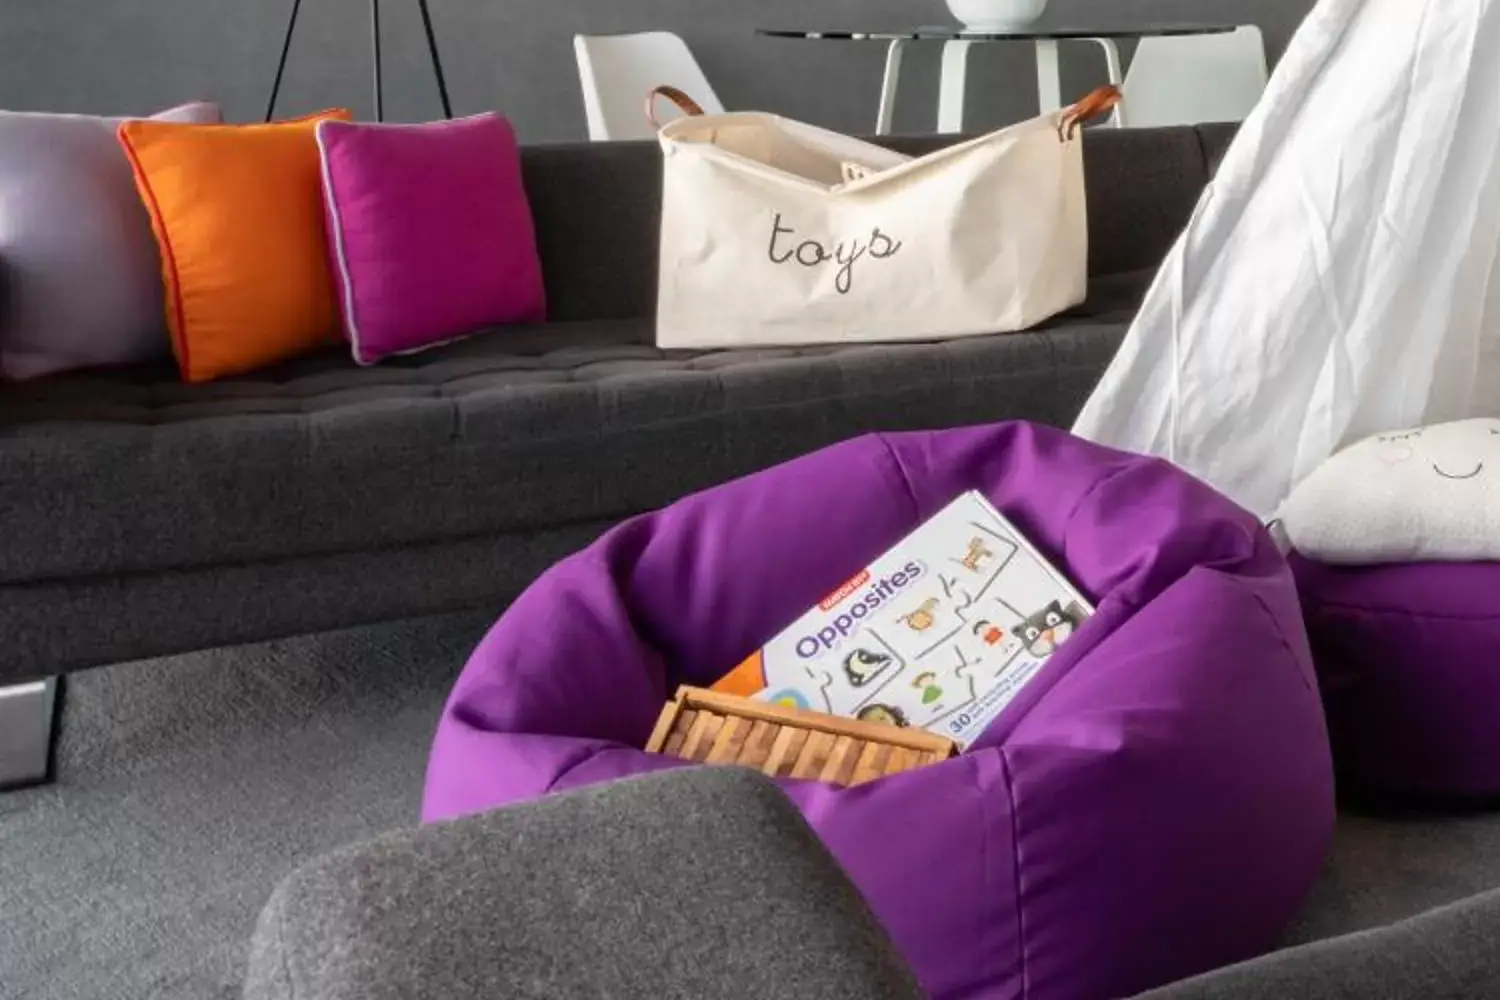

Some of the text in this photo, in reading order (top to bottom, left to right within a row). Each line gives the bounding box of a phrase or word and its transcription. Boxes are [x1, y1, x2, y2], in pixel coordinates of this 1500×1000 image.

[768, 213, 901, 294] toys
[795, 560, 921, 658] Opposites
[950, 713, 971, 733] 30
